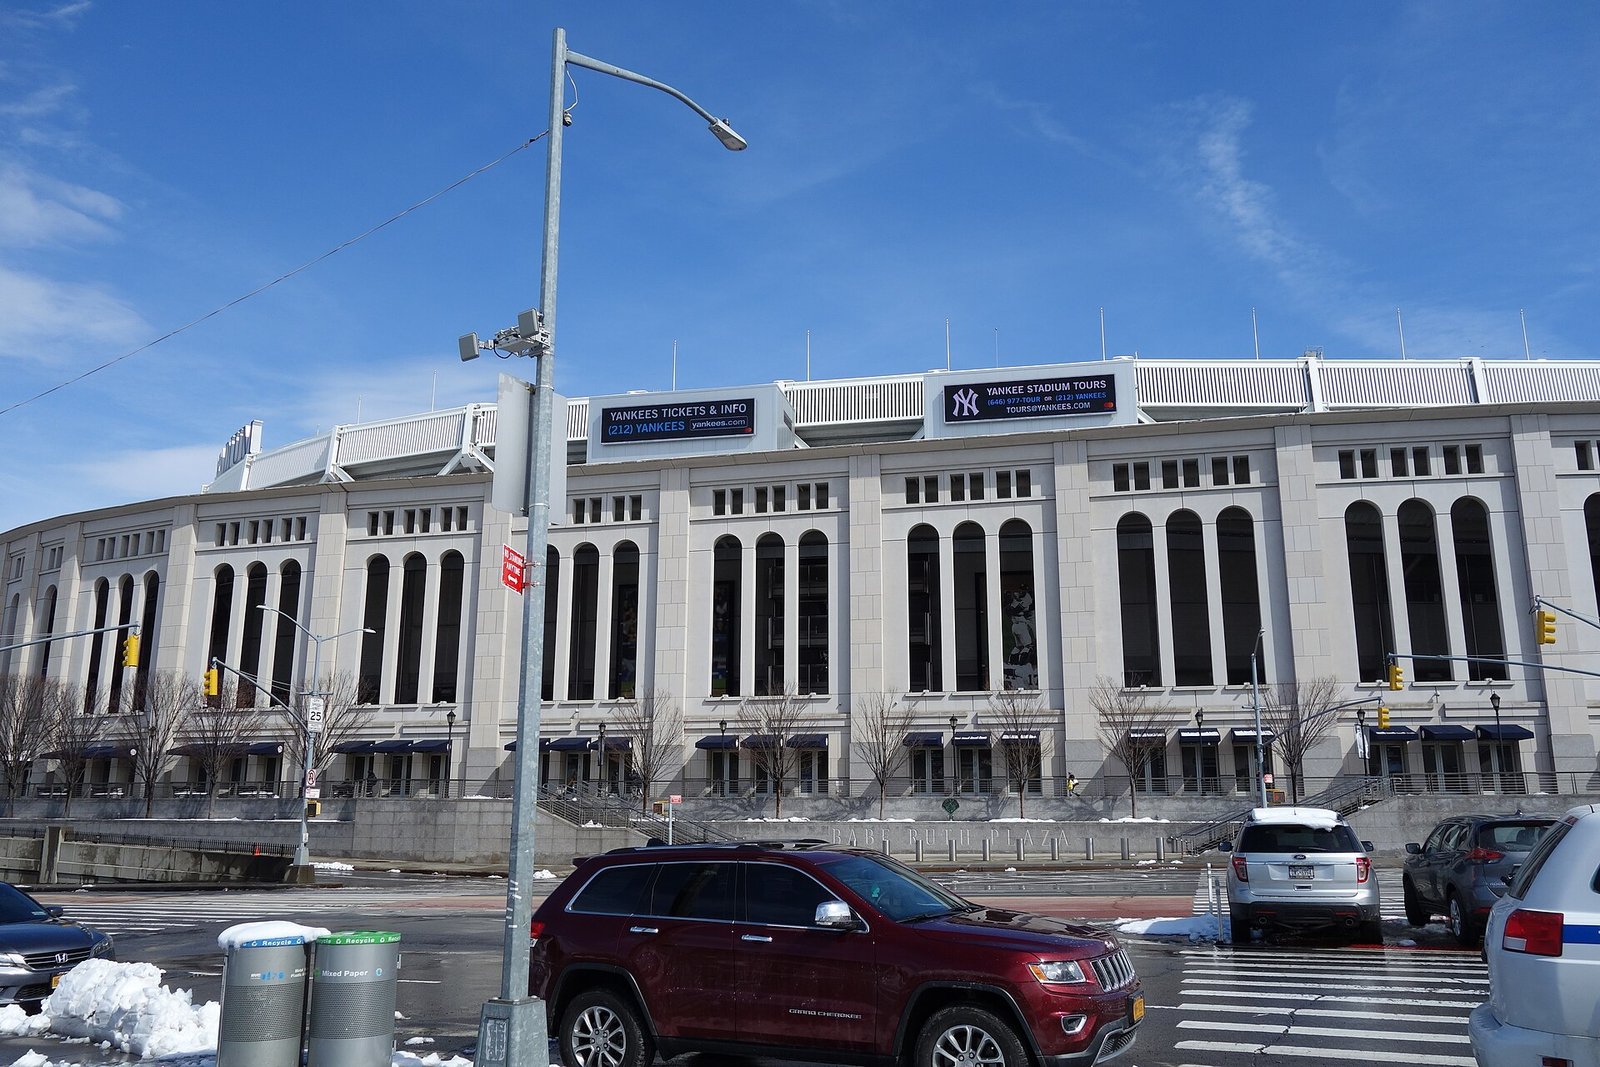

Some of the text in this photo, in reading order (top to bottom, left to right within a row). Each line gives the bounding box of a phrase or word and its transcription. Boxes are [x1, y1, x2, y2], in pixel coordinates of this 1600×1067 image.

[986, 380, 1107, 396] YANKEE STADIUM TOURS
[987, 398, 1006, 406] (646)
[1006, 396, 1041, 405] 977-TOUR
[1055, 394, 1074, 402] (212)
[1075, 391, 1107, 400] YANKEES
[610, 403, 747, 421] YANKEES TICKETS & INFO
[1006, 402, 1091, 414] TOURS@YANKEES.COM
[608, 418, 746, 436] (212) YANKEES yankees.com
[310, 711, 322, 721] 25
[832, 828, 1070, 847] BABE RUTH PLAZA
[261, 939, 292, 947] Recycle
[345, 937, 375, 945] Recycle
[343, 970, 368, 979] Paper
[788, 1008, 817, 1016] GRAND
